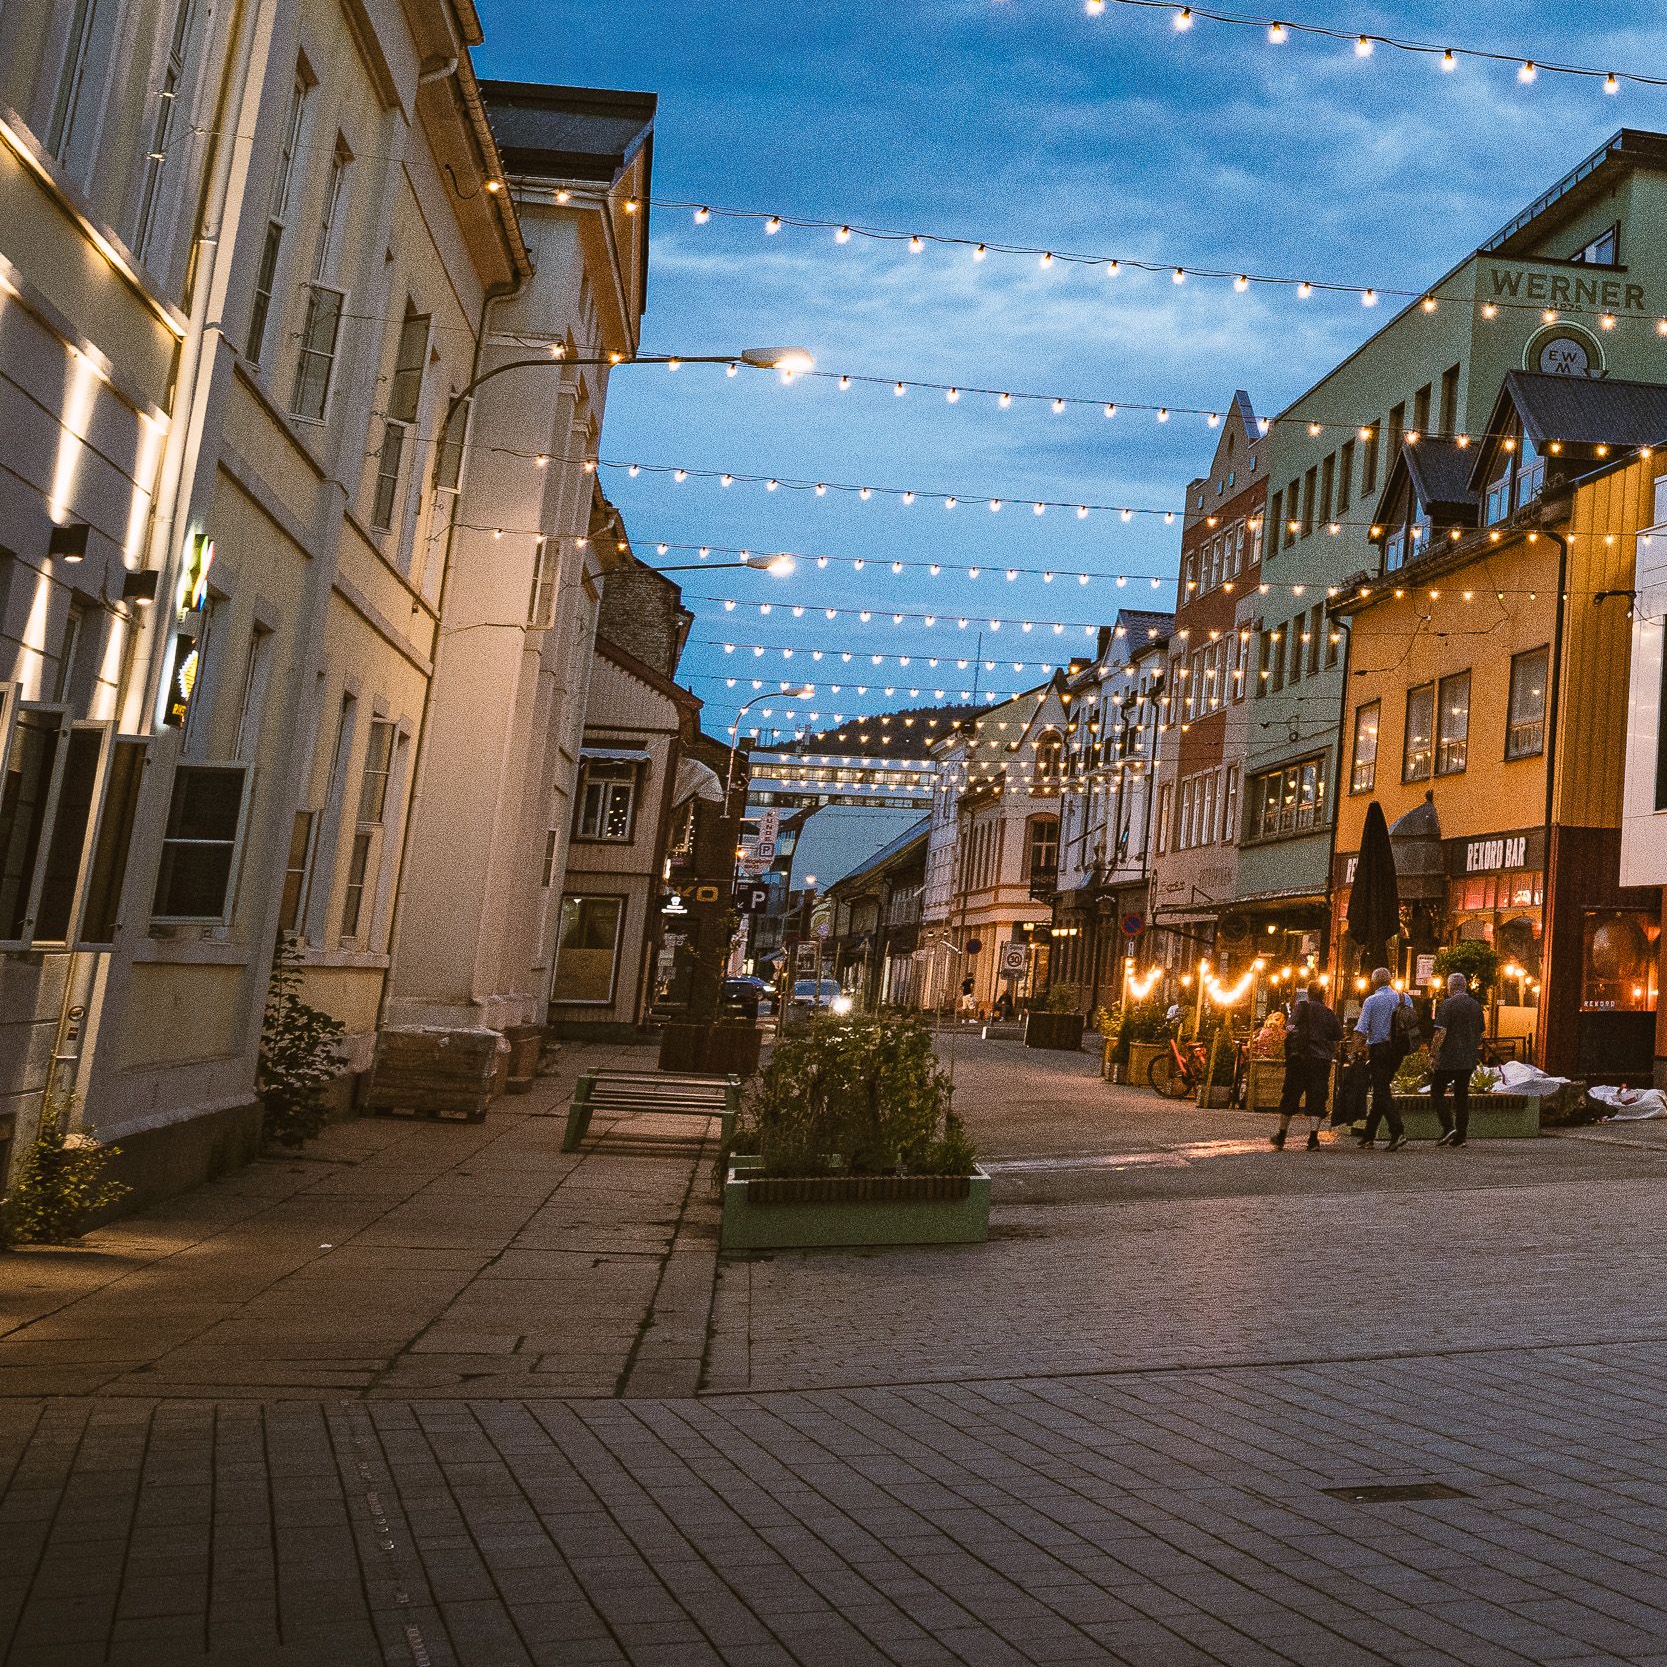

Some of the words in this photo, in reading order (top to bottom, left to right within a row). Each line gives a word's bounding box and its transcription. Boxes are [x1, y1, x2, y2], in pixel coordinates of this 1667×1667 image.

[1490, 269, 1645, 310] WERNER
[1466, 839, 1503, 872] REKORD
[1505, 837, 1526, 868] BAR
[751, 891, 767, 909] P
[1009, 955, 1020, 964] 30
[1583, 1000, 1617, 1008] REKORD
